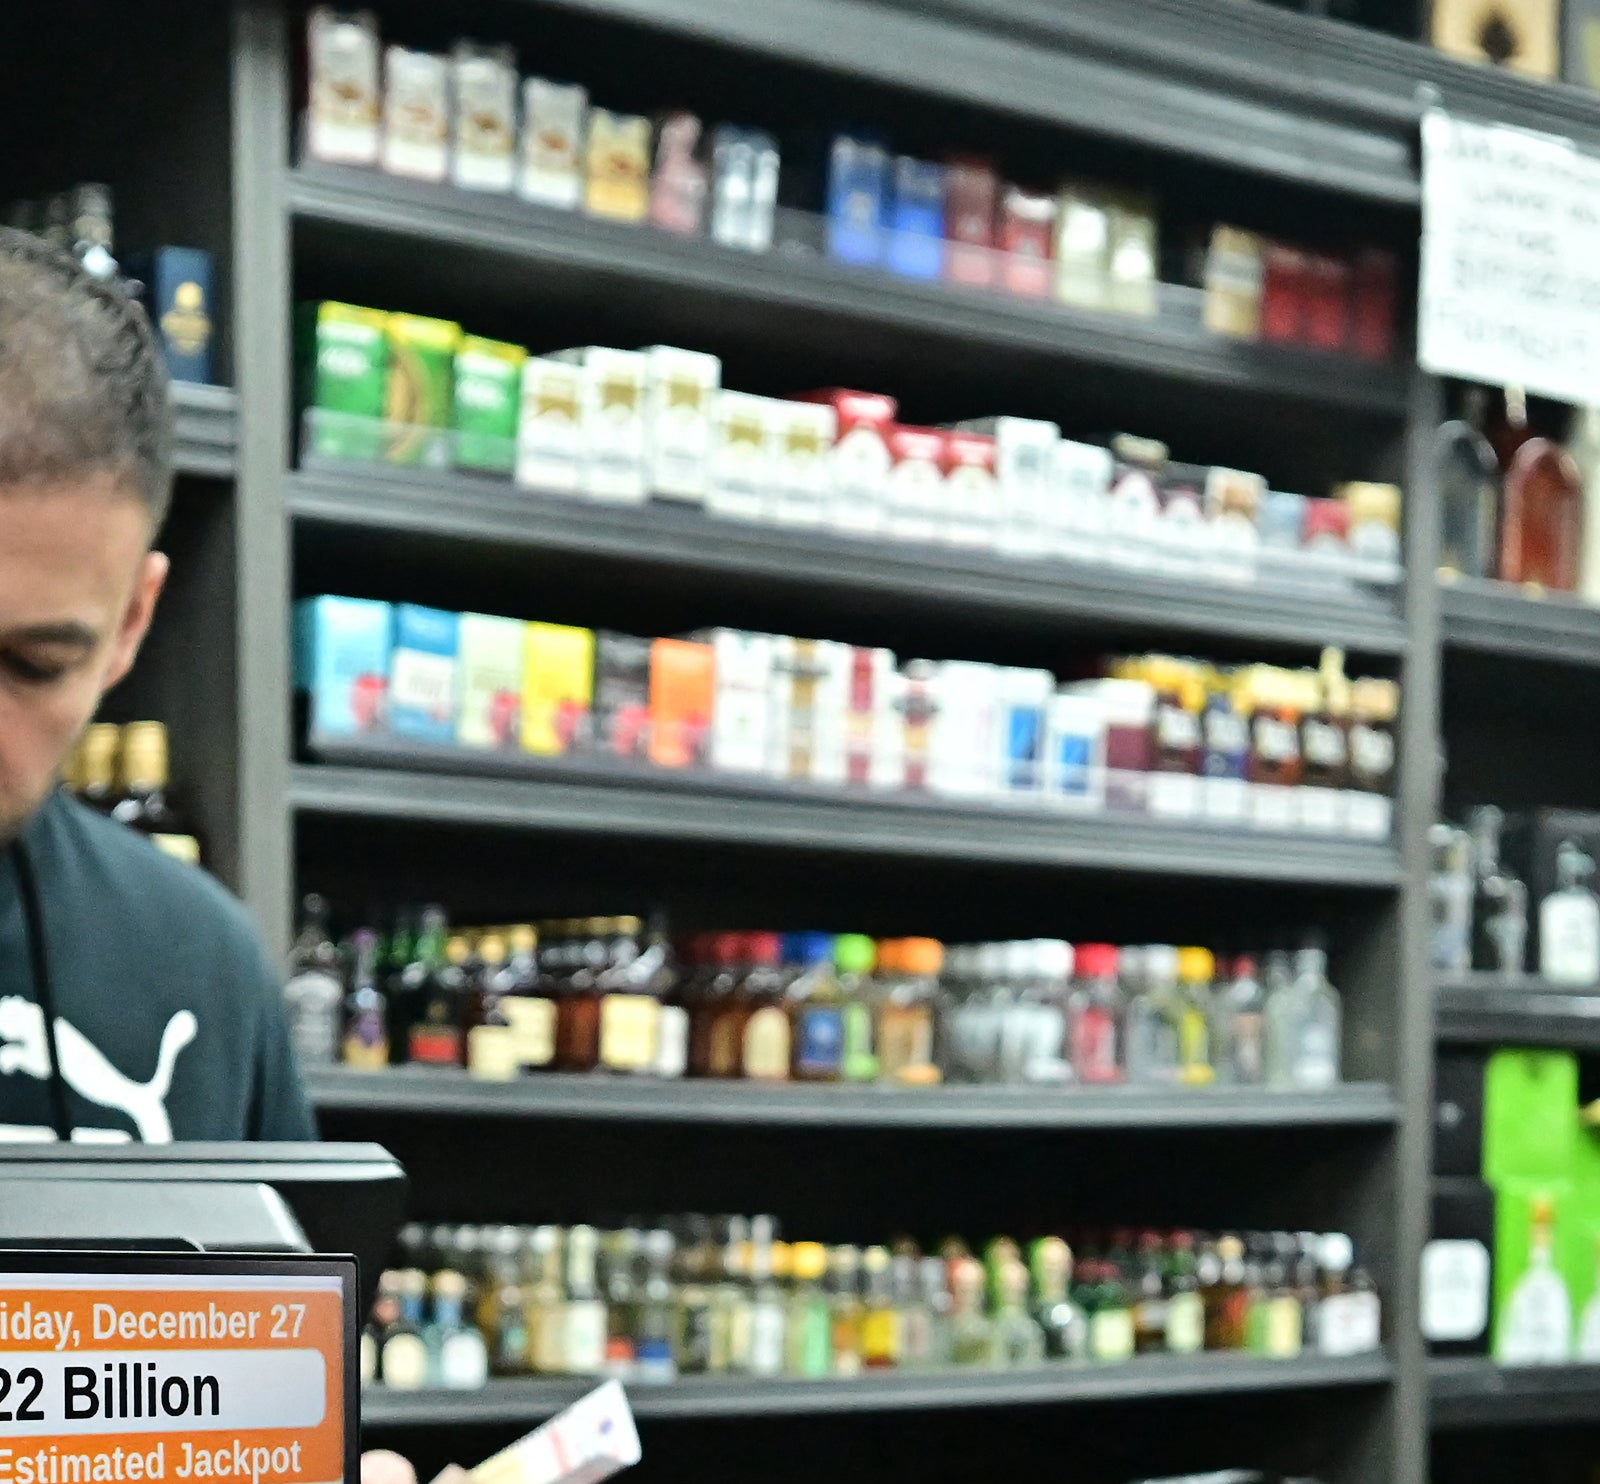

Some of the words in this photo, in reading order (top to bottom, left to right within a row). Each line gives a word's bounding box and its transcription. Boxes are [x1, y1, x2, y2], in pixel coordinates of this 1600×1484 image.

[94, 1303, 260, 1341] December
[270, 1303, 306, 1338] 27
[64, 1364, 220, 1419] Billion
